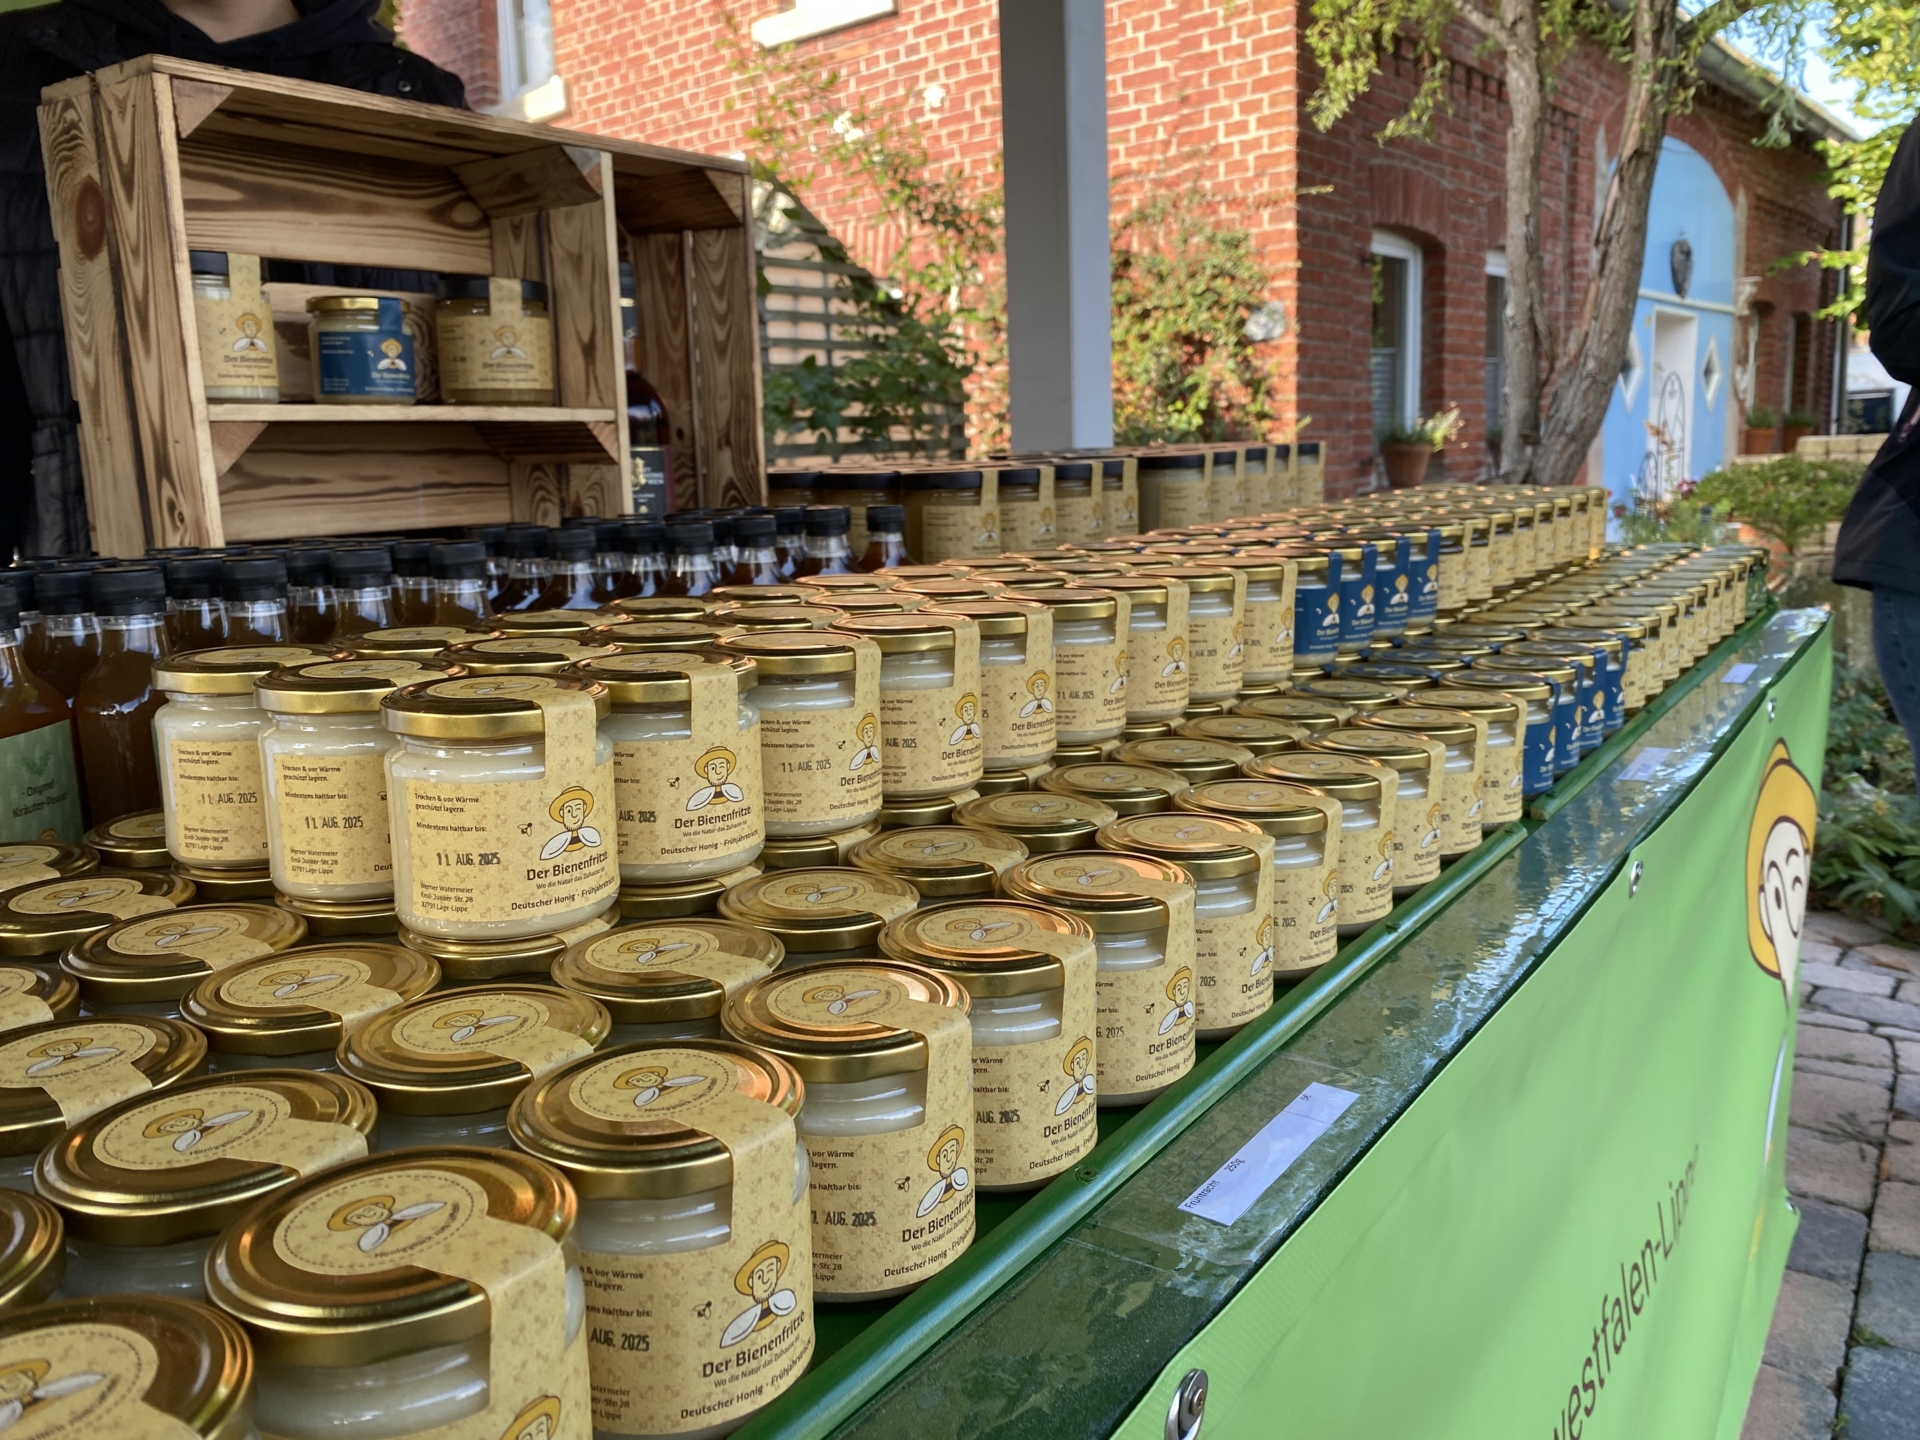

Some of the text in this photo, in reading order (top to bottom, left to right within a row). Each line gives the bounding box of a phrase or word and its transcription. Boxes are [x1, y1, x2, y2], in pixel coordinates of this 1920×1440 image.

[1154, 681, 1166, 689] Der
[1082, 691, 1094, 699] 2025
[1011, 723, 1025, 731] Der
[885, 738, 917, 748] AUG. 2025
[942, 751, 955, 760] Der
[797, 759, 831, 772] AUG. 2025
[840, 777, 855, 787] Der
[217, 792, 258, 804] AUG. 2025
[415, 793, 436, 801] Trocken
[830, 801, 856, 810] Deutscher
[322, 816, 364, 829] AUG. 2025
[619, 810, 657, 823] AUG. 2025
[674, 806, 752, 829] Der Bienenfritze
[416, 822, 449, 831] Mindestens
[726, 821, 743, 830] Zuhause
[660, 829, 759, 855] Deutscher Honig Frühjahrstracht
[455, 853, 476, 866] AUG.
[1414, 853, 1425, 861] Der
[306, 866, 334, 874] Lage-Lippe
[526, 851, 608, 880] Der Bienenfritze
[583, 869, 600, 879] Zuhause
[420, 883, 473, 893] Werner Watermeier
[511, 876, 615, 910] Deutscher Honig Frühjahrstracht
[1340, 884, 1354, 893] 2025
[1366, 886, 1376, 895] Der
[436, 903, 468, 912] Lage-Lippe
[1281, 917, 1296, 927] 2025
[1310, 929, 1321, 939] Der
[1300, 952, 1321, 961] Deutscher
[1199, 976, 1216, 986] 2025
[1241, 982, 1255, 994] Der
[1231, 1007, 1256, 1019] Deutscher
[1106, 1026, 1124, 1038] 2025
[1149, 1042, 1165, 1055] Der
[1135, 1063, 1180, 1082] Deutscher Honig
[976, 1110, 996, 1124] AUG.
[1043, 1125, 1062, 1138] Der
[1067, 1130, 1078, 1140] Natur
[827, 1150, 854, 1158] Wärme
[1029, 1145, 1080, 1169] Deutscher Honig
[811, 1161, 838, 1169] lagern.
[1224, 1157, 1246, 1173] 250g
[1184, 1180, 1220, 1209] Frühtracht
[825, 1211, 877, 1227] AUG. 2025
[902, 1189, 973, 1242] Der Bienenfritze
[922, 1240, 931, 1248] die
[932, 1231, 946, 1245] Natur
[884, 1250, 947, 1277] Deutscher Honig
[586, 1266, 644, 1279] & vor Wärme
[595, 1280, 625, 1291] lagern.
[602, 1306, 634, 1317] haltbar
[636, 1308, 652, 1317] bis:
[590, 1327, 650, 1352] AUG. 2025
[702, 1311, 805, 1378] Der Bienenfritze
[714, 1342, 795, 1388] Wo die Natur das Zuhause
[619, 1400, 630, 1408] 28
[681, 1384, 763, 1419] Deutscher Honig
